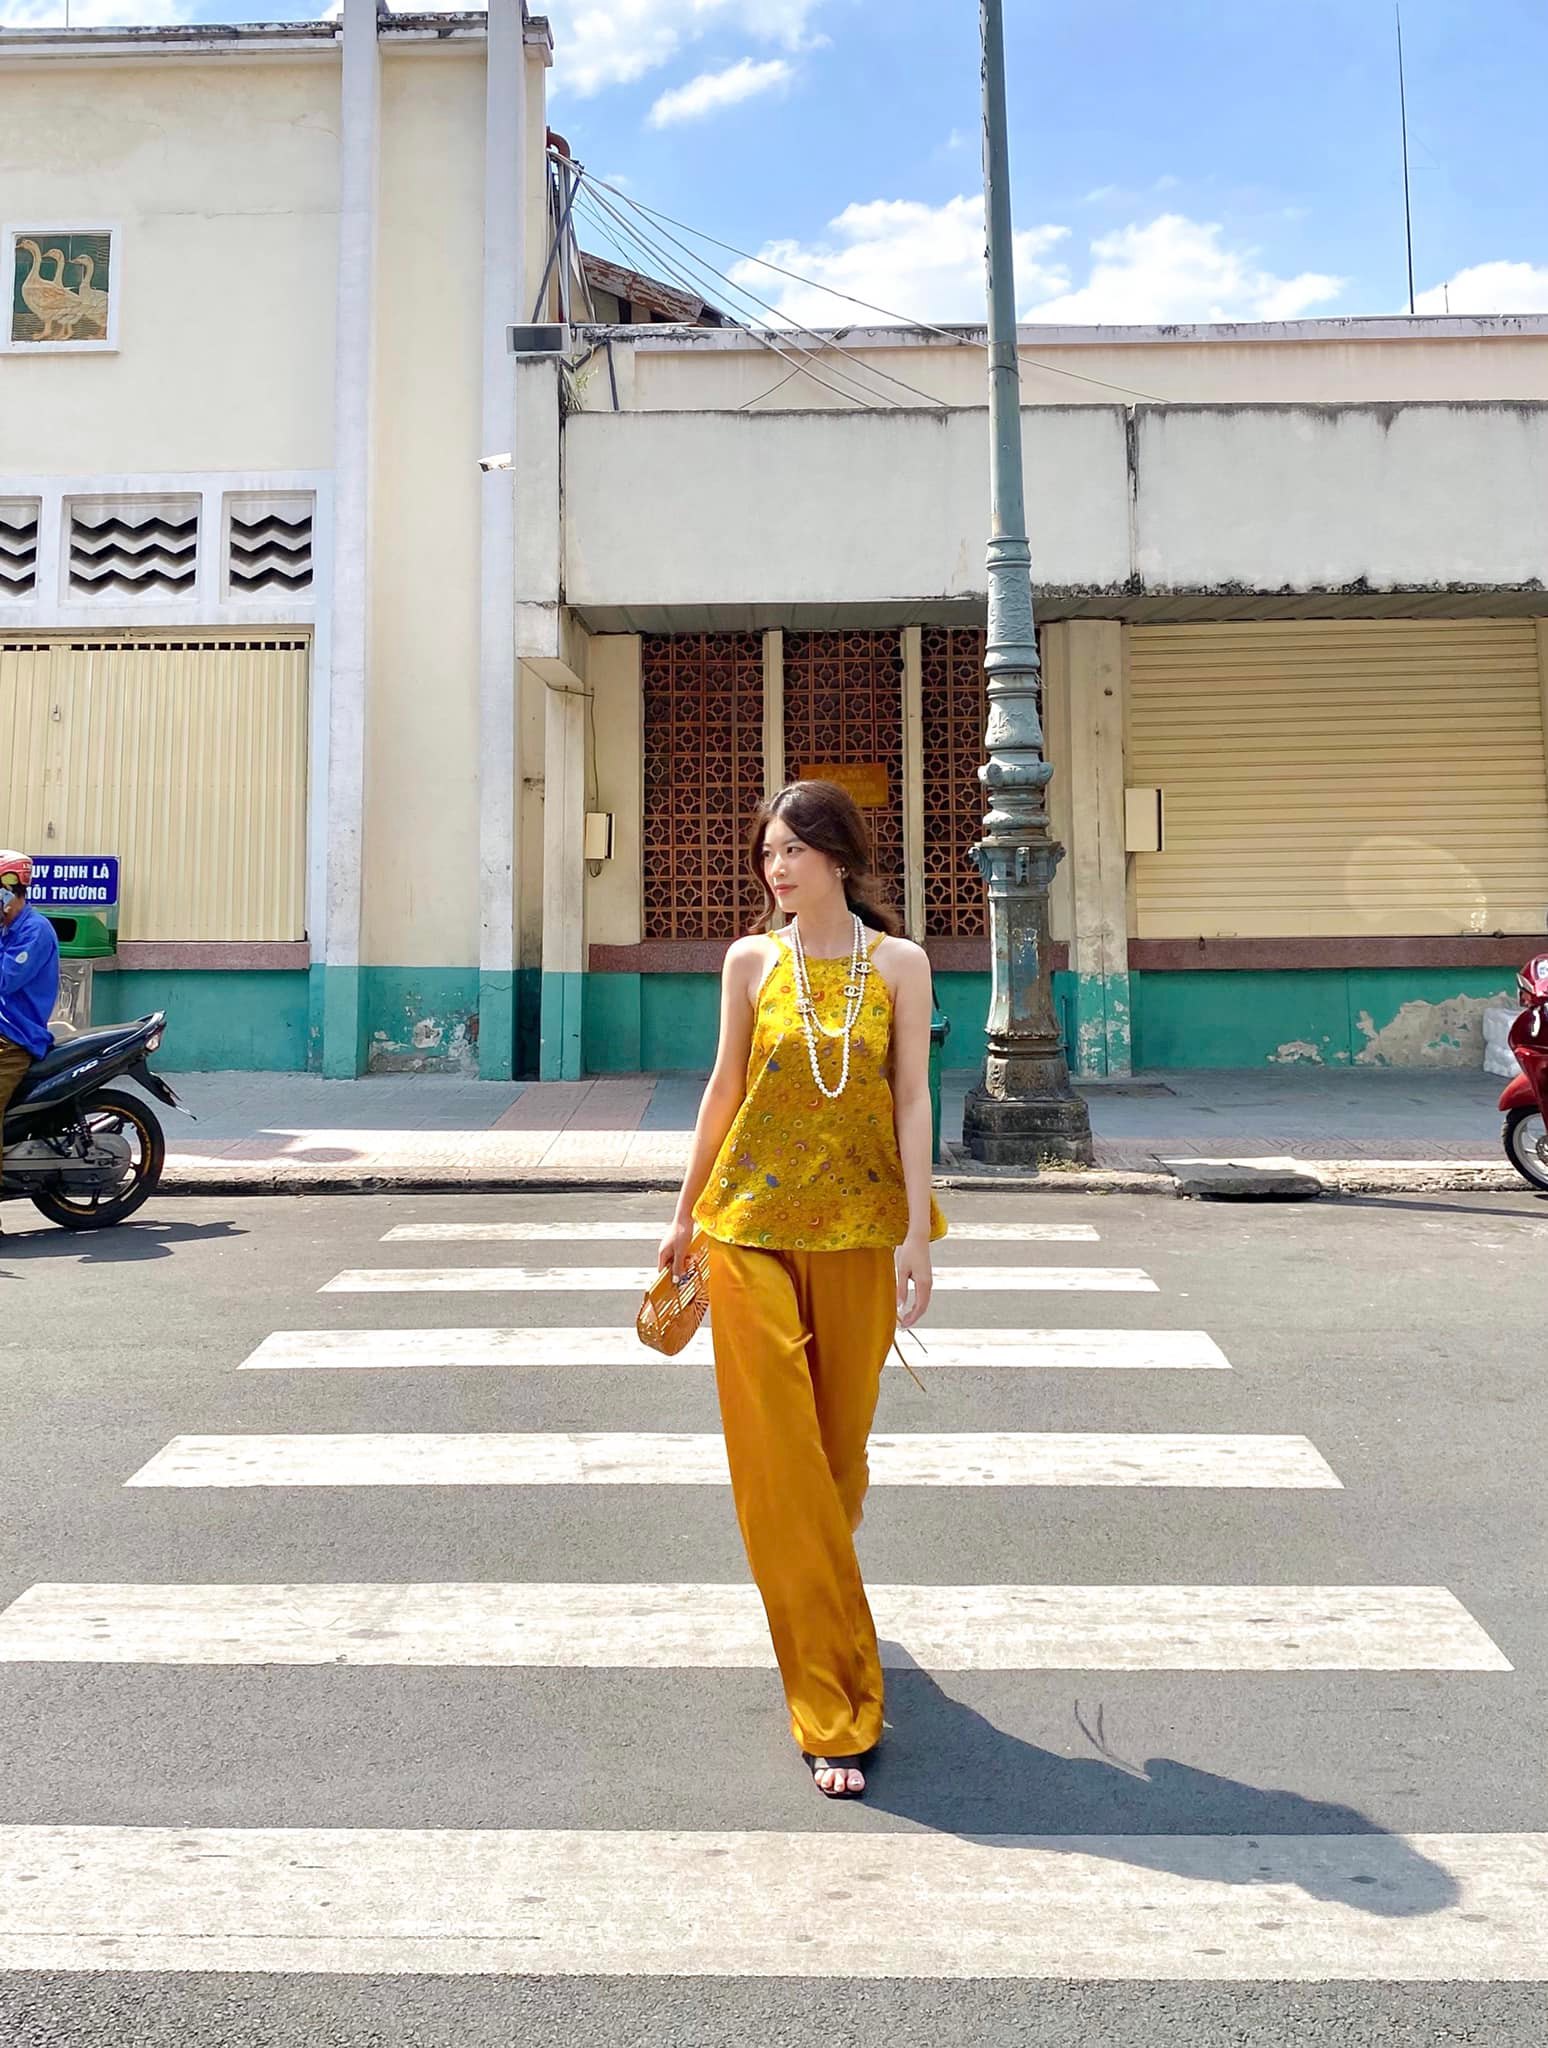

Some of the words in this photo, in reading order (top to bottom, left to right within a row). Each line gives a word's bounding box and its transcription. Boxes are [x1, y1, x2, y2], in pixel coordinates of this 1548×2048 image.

[31, 864, 49, 878] UY
[53, 865, 88, 881] ĐỊNH
[51, 884, 107, 900] TRƯỜNG
